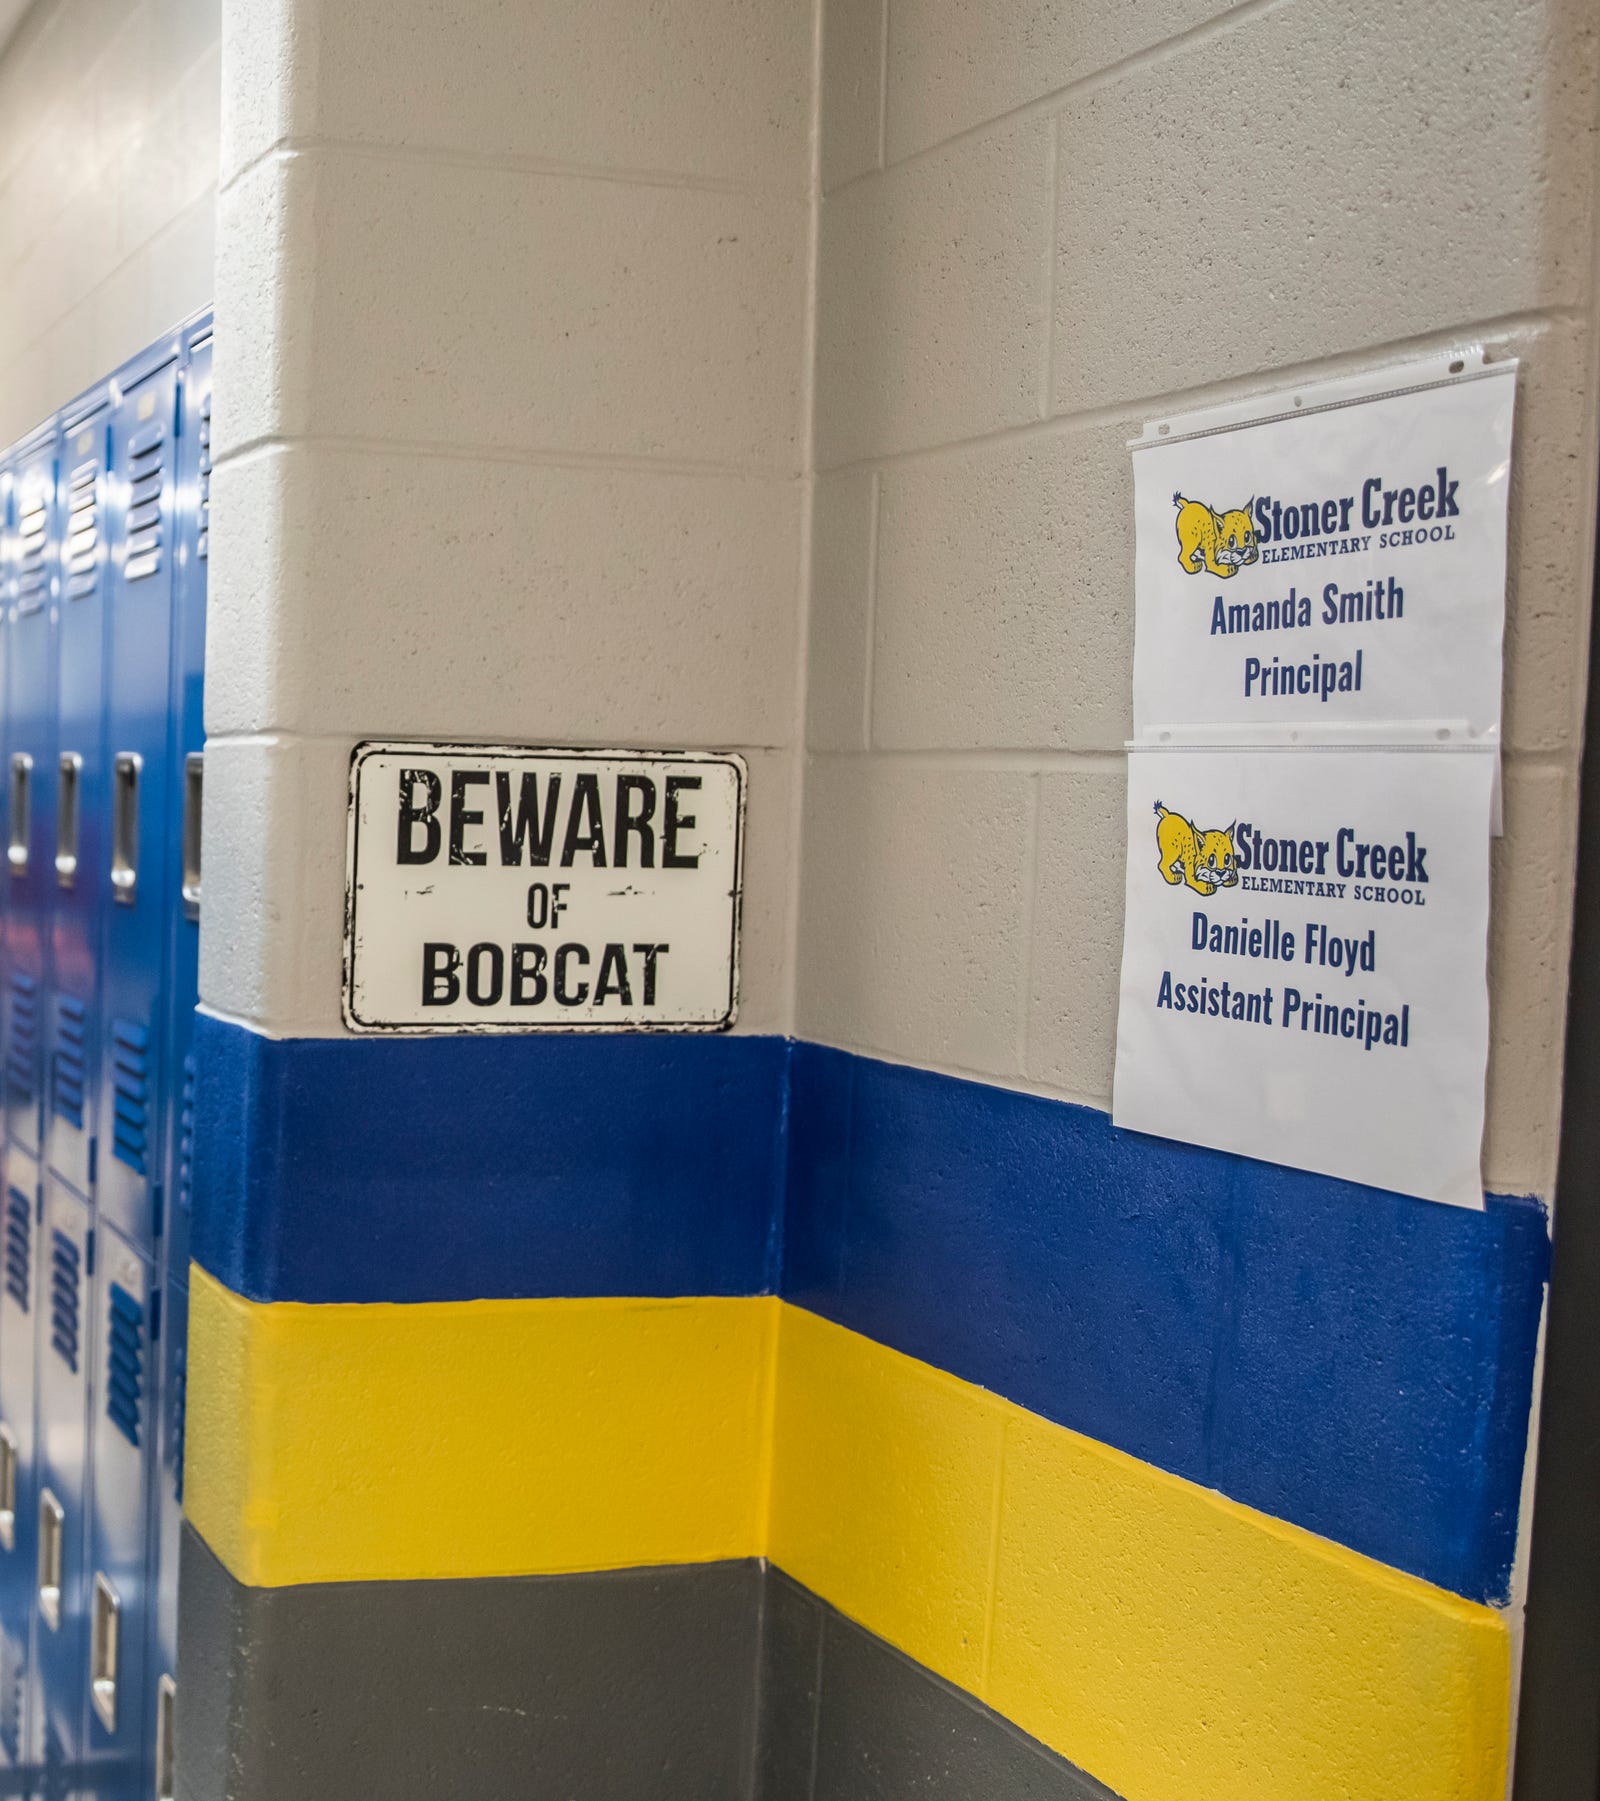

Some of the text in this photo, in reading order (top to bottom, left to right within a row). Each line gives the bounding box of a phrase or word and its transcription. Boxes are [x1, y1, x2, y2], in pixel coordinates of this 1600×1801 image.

[1255, 466, 1460, 544] Stoner Creek
[1262, 525, 1455, 565] ELEMENTARY SCHOOL
[1210, 576, 1404, 636] Amanda Smith
[1244, 650, 1362, 702] Principal
[396, 768, 703, 869] BEWARE
[1236, 822, 1430, 883] Stoner Creek
[527, 883, 570, 929] OF
[1241, 876, 1426, 906] ELEMENTARY SCHOOL
[421, 942, 670, 1007] BOBCAT
[1191, 911, 1376, 977] Danielle Floyd
[1156, 971, 1410, 1051] Assistant Principal
